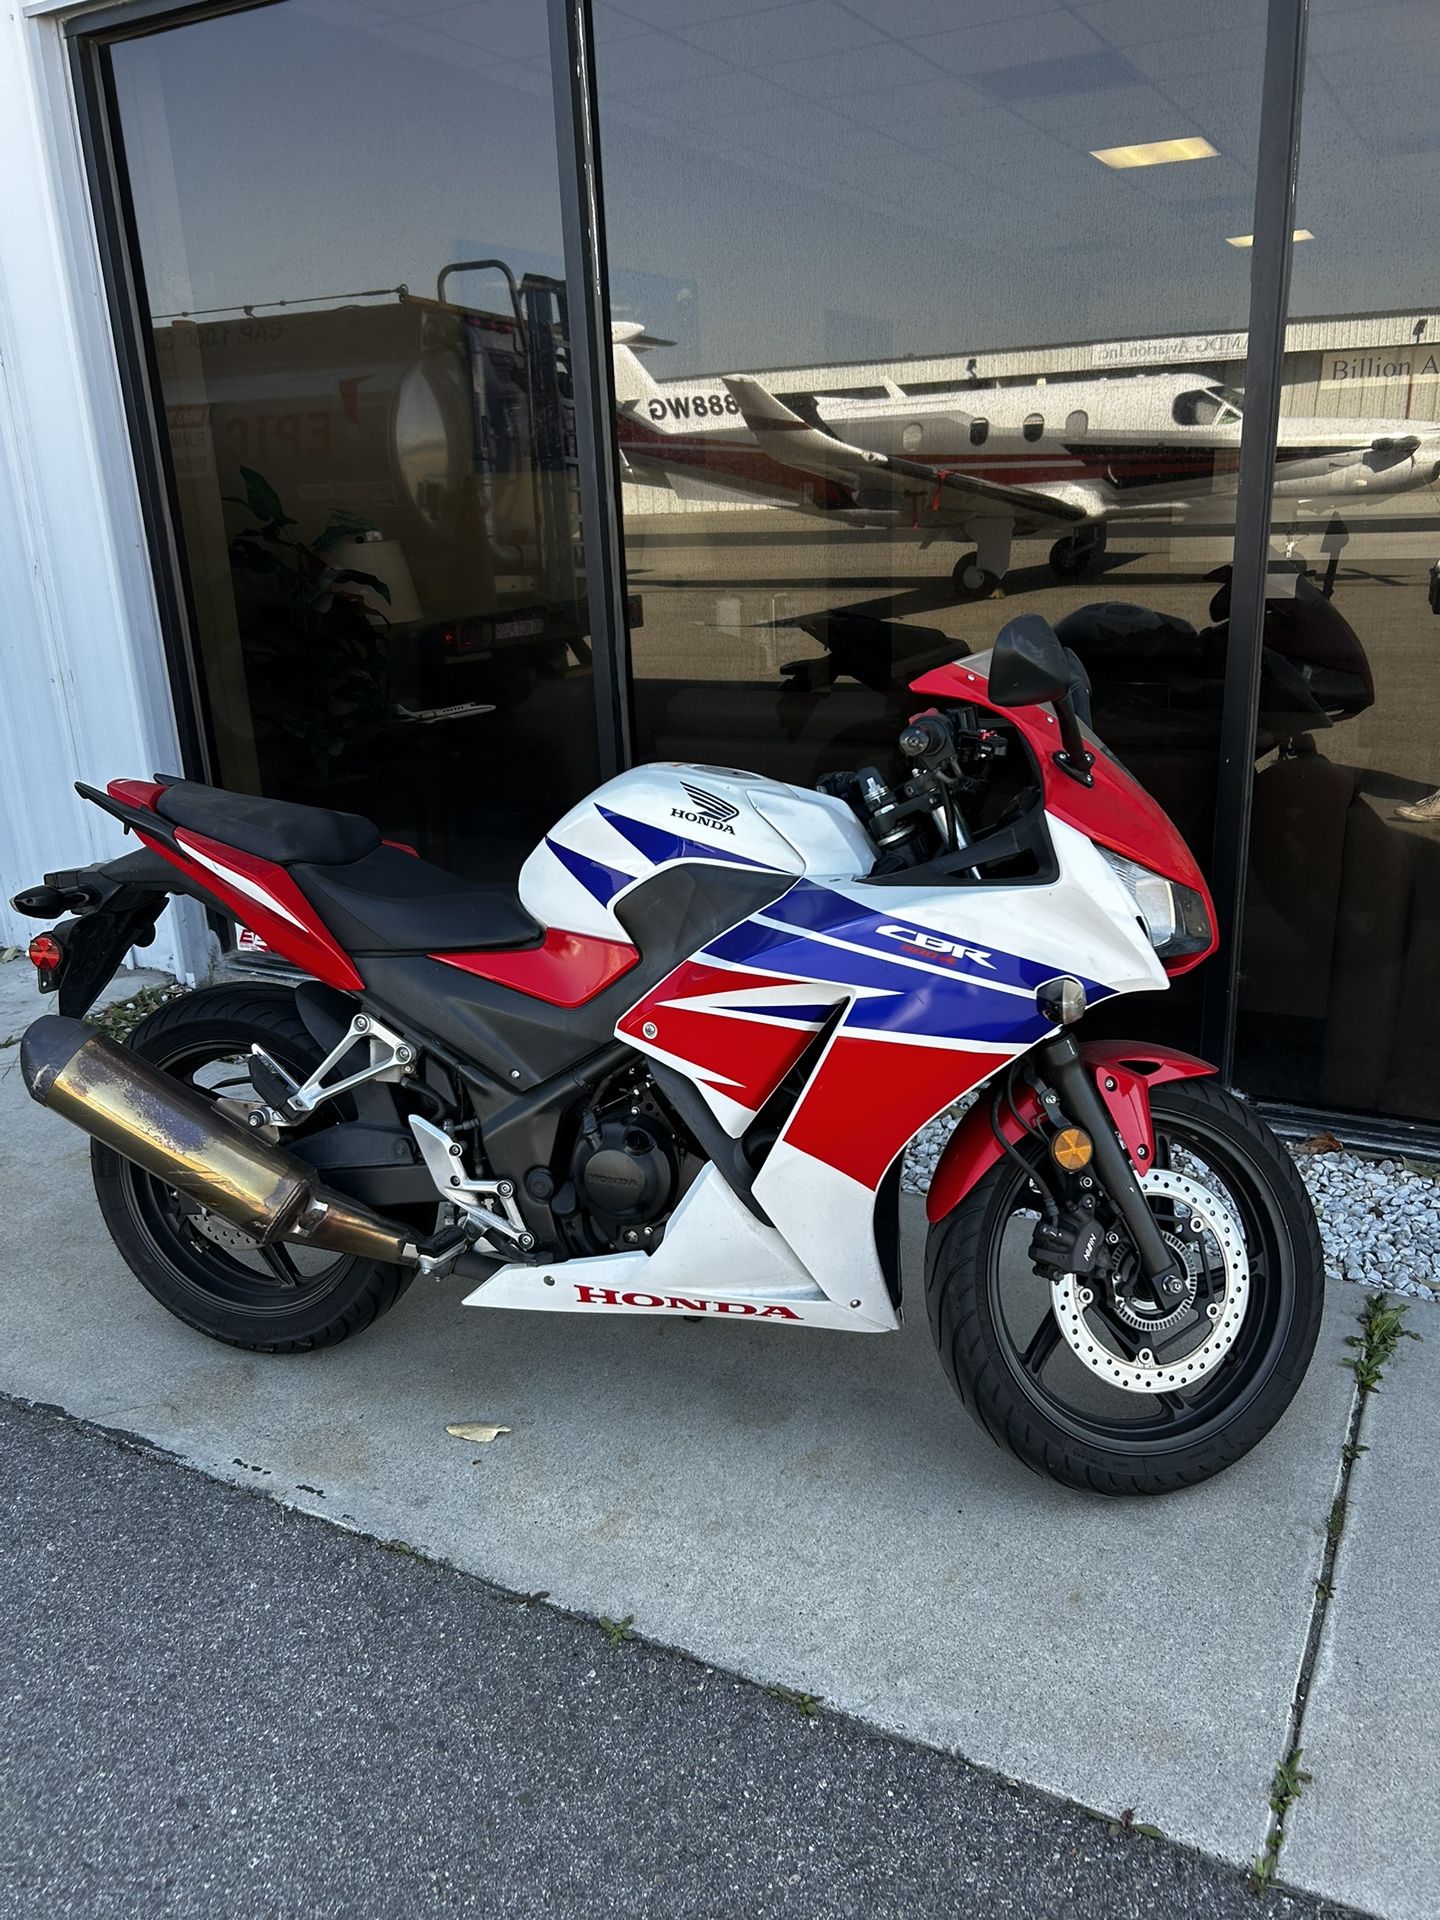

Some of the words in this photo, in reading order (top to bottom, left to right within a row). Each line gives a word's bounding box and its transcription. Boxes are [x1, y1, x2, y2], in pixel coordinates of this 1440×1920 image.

[1332, 356, 1411, 381] Billion
[670, 806, 737, 836] HONDA
[875, 924, 997, 970] CBR
[587, 1172, 640, 1189] HONDA
[574, 1284, 805, 1321] HONDA
